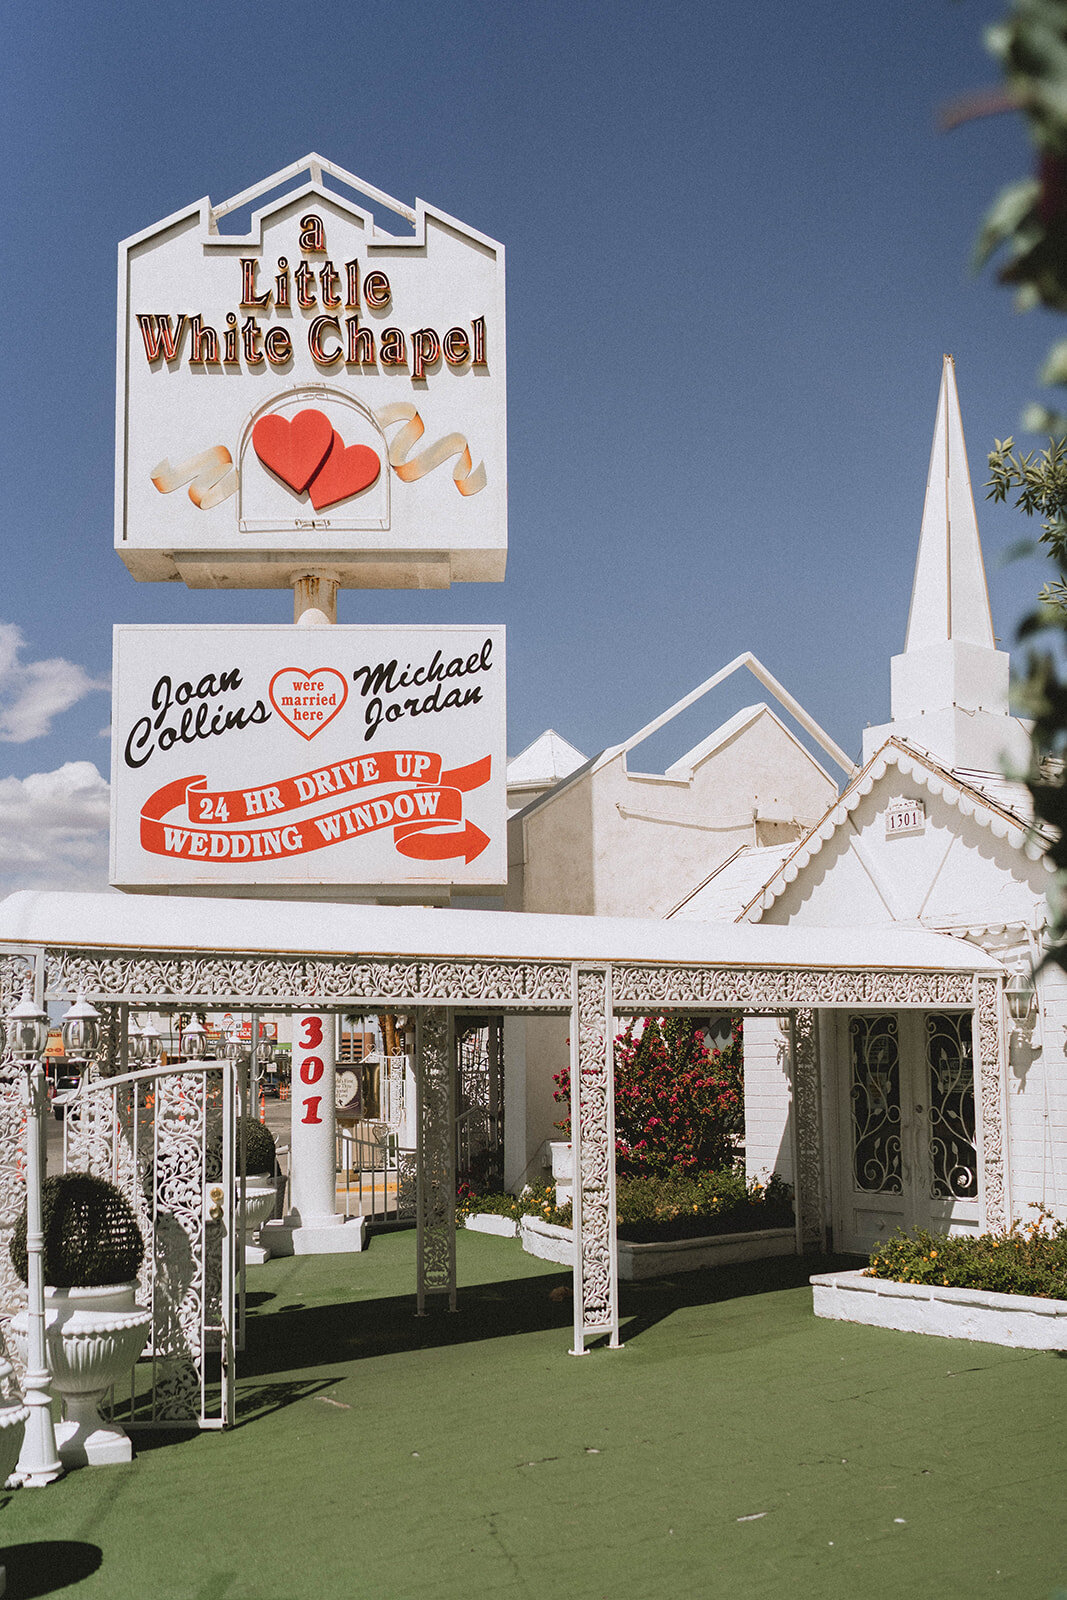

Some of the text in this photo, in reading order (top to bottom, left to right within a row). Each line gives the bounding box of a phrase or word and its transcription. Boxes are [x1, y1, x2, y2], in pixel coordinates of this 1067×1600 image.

[299, 213, 326, 252] a
[239, 256, 392, 310] Little
[135, 312, 488, 381] White Chapel
[292, 681, 325, 691] were
[353, 638, 493, 697] Michael
[152, 668, 243, 730] Joan
[281, 693, 337, 706] married
[293, 708, 324, 721] here
[364, 683, 483, 741] Jordan
[124, 700, 272, 768] Collins
[199, 754, 431, 822] 24 HR DRIVE UP
[163, 791, 441, 858] WEDDING WINDOW
[298, 979, 324, 1125] 301
